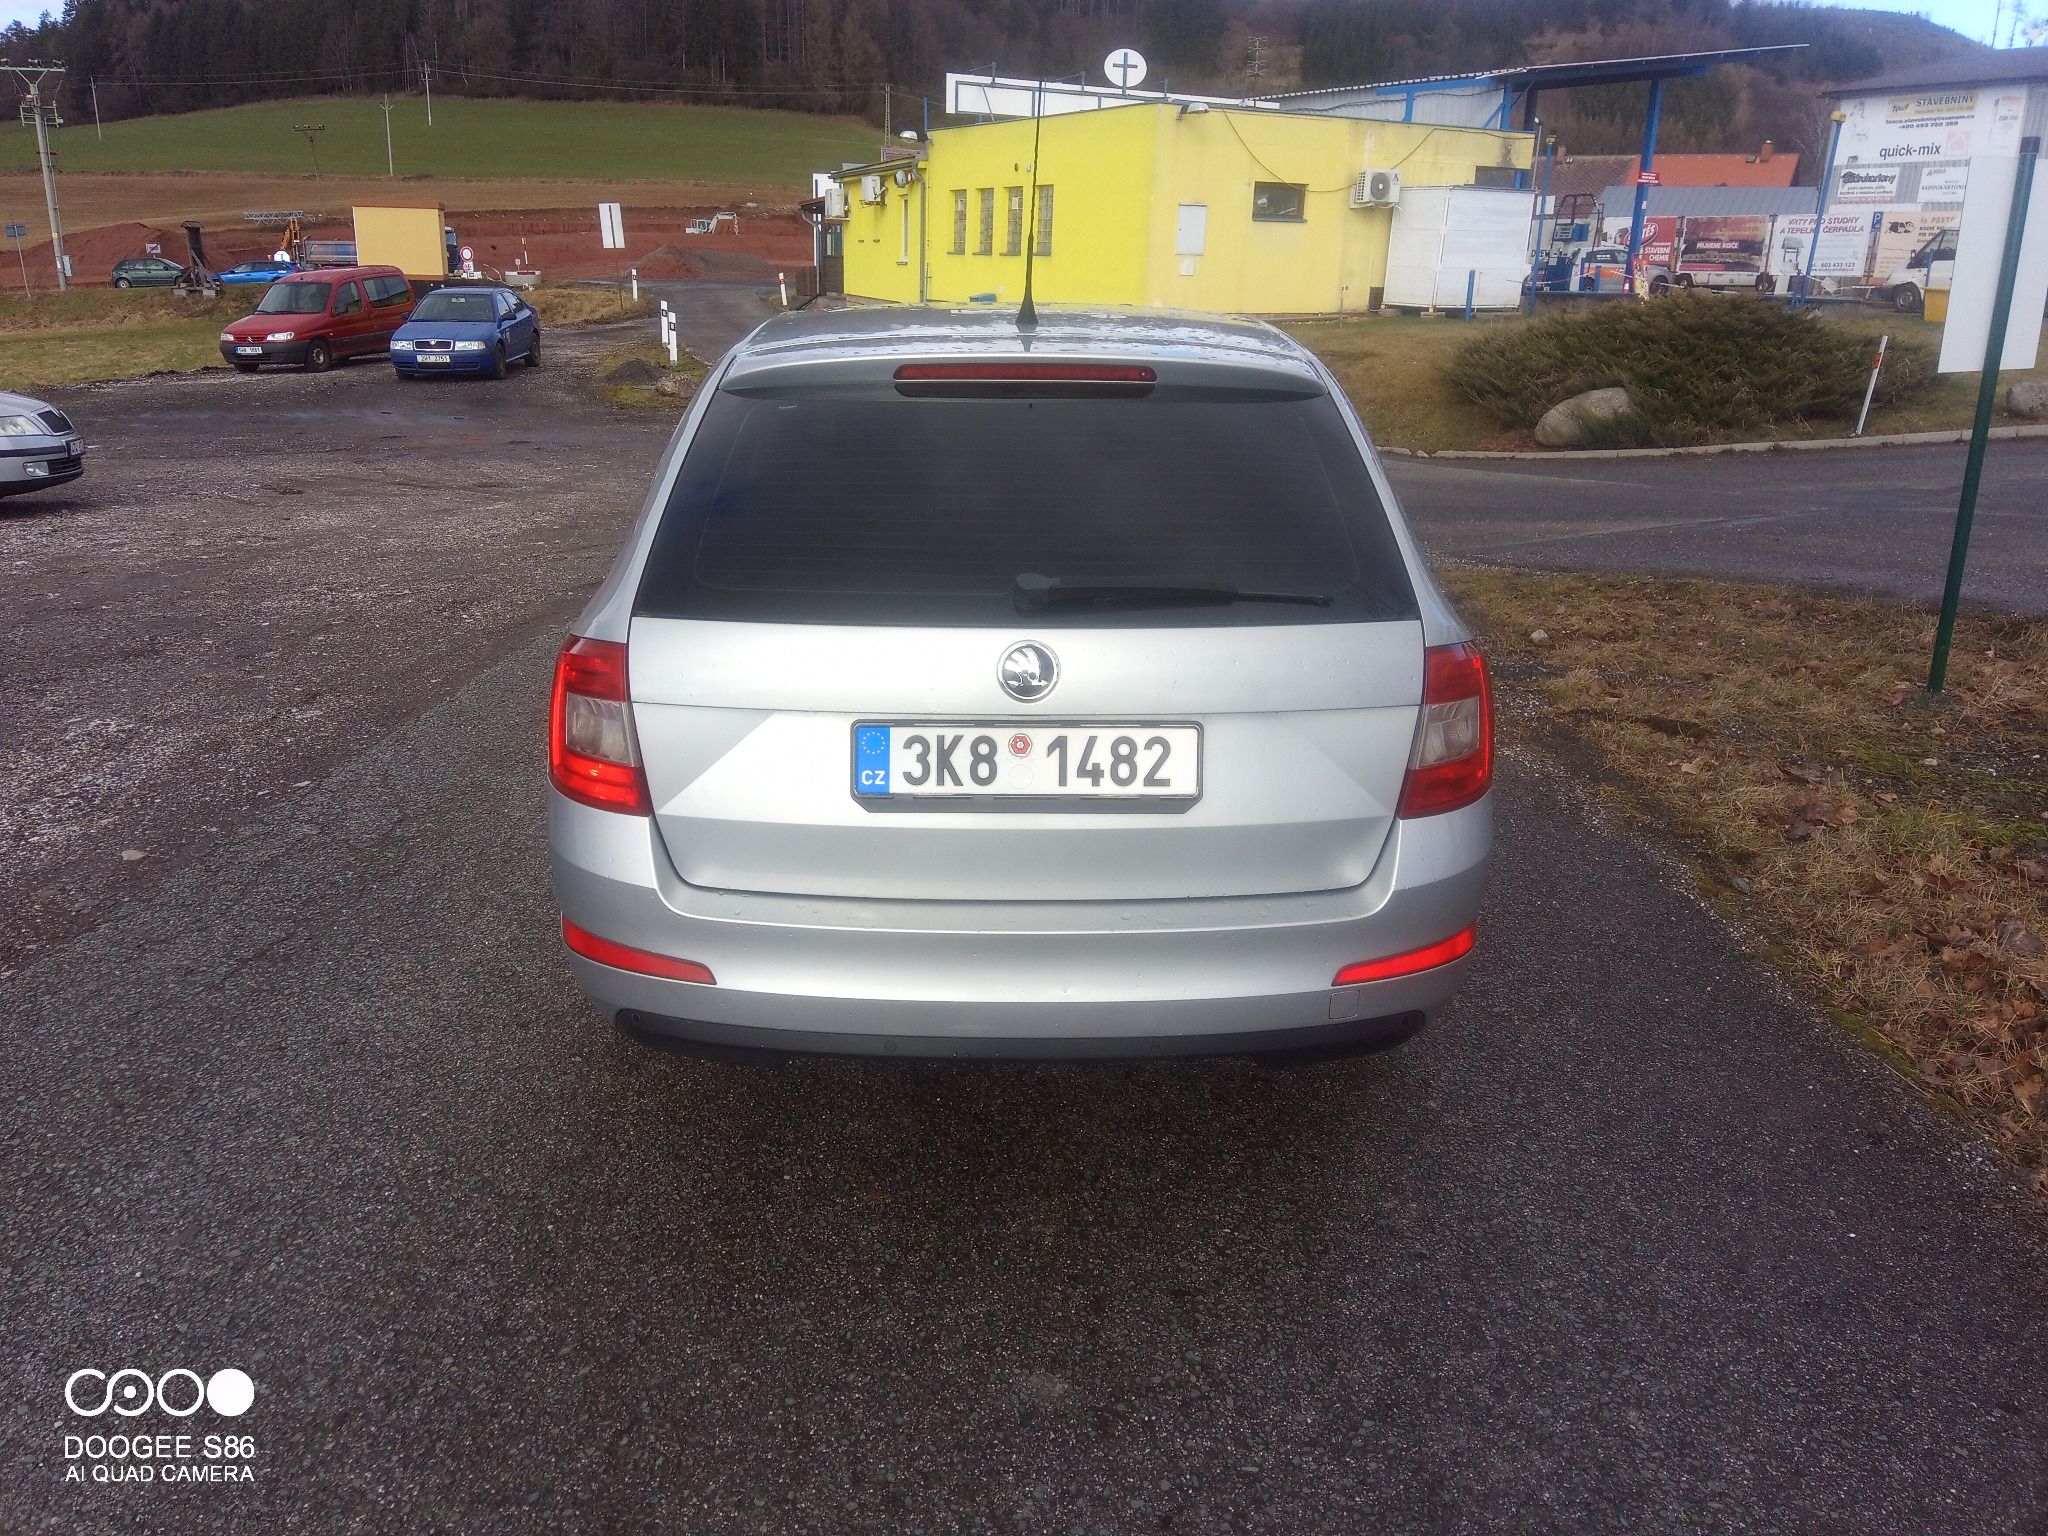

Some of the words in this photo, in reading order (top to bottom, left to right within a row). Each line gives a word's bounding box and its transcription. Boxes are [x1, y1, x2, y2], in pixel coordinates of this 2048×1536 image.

[1916, 95, 1974, 107] STAVEBNINY
[1879, 143, 1942, 160] quick-mix
[1789, 218, 1808, 226] VRTY
[1808, 217, 1826, 226] PO
[1827, 216, 1860, 225] STUDNY
[1787, 226, 1817, 234] TEPELN
[1822, 225, 1864, 234] ČERPADLA
[1645, 245, 1671, 254] STAVEBNÍ
[1649, 254, 1670, 262] CHEMIE
[902, 734, 998, 787] 3K8
[1047, 735, 1171, 788] 1482
[861, 769, 886, 785] CZ
